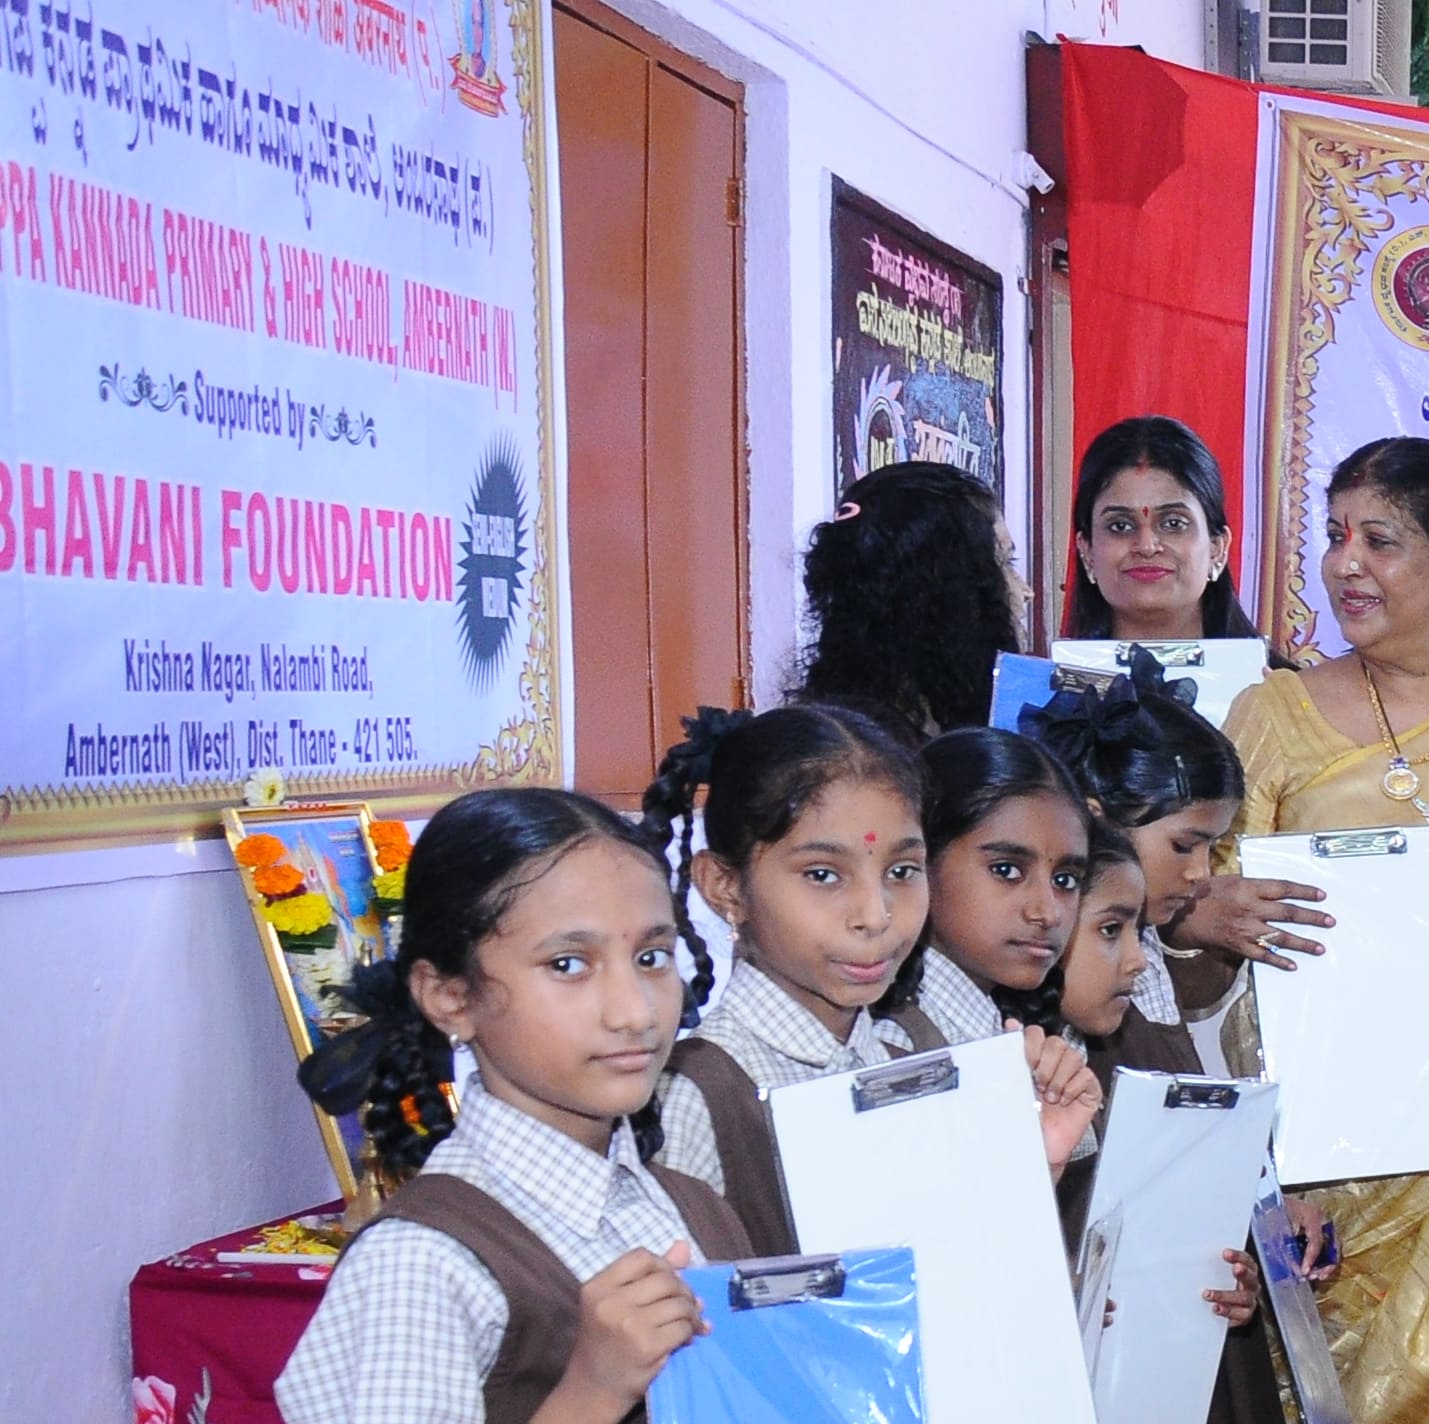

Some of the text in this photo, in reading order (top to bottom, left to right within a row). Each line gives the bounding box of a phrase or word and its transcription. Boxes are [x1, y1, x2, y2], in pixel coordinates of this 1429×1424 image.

[50, 172, 160, 311] KANNADA
[163, 207, 255, 333] PRIMARY
[260, 236, 278, 338] &
[279, 242, 326, 350] HIGH
[331, 256, 398, 384] SCHOOL,
[403, 279, 488, 386] AMBERNATH
[493, 305, 518, 414] (W.)
[194, 369, 305, 450] Supported by
[221, 490, 453, 602] FOUNDATION
[124, 638, 373, 702] Krishna Nagar, Nalambi Road,
[65, 721, 173, 777] Ambernath
[247, 718, 285, 769] Dist.
[289, 717, 337, 769] Thane
[353, 721, 382, 764] 421
[386, 716, 418, 762] 505.
